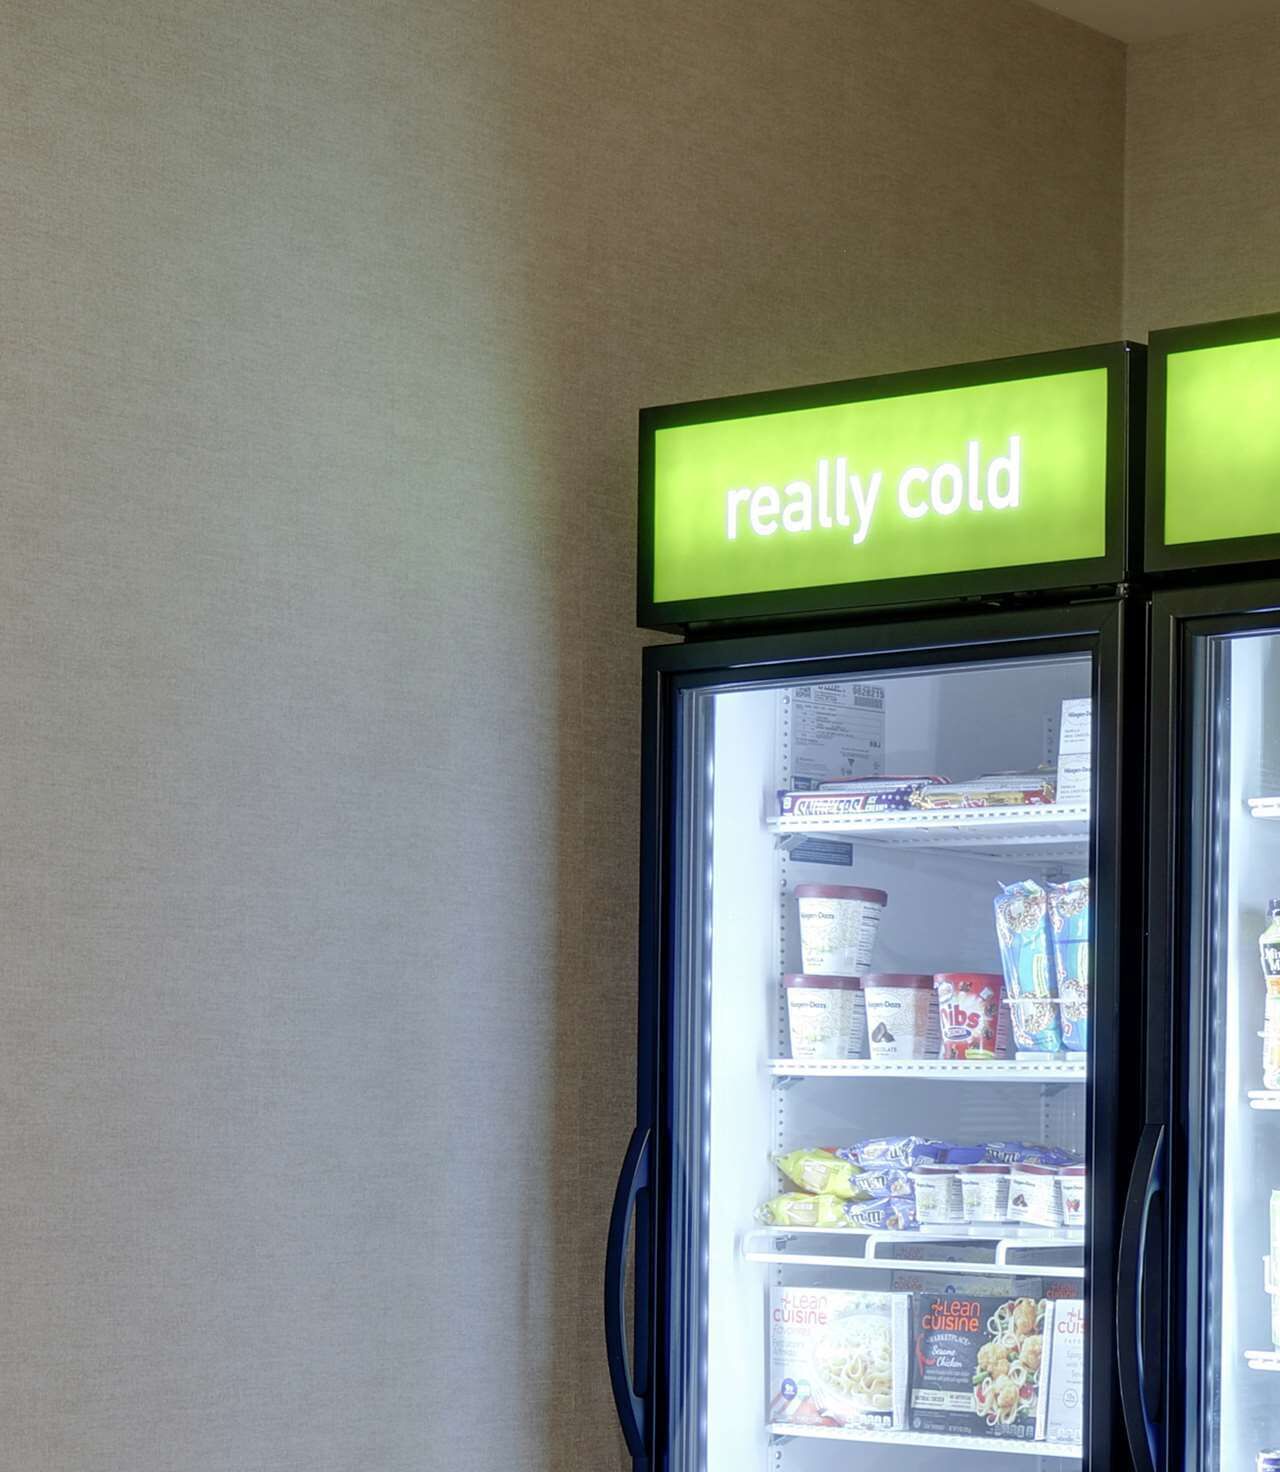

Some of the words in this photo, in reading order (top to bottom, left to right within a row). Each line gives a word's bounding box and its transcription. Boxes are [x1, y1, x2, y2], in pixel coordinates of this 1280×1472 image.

[726, 456, 881, 544] really
[897, 436, 1022, 519] cold
[943, 1300, 981, 1317] Lean
